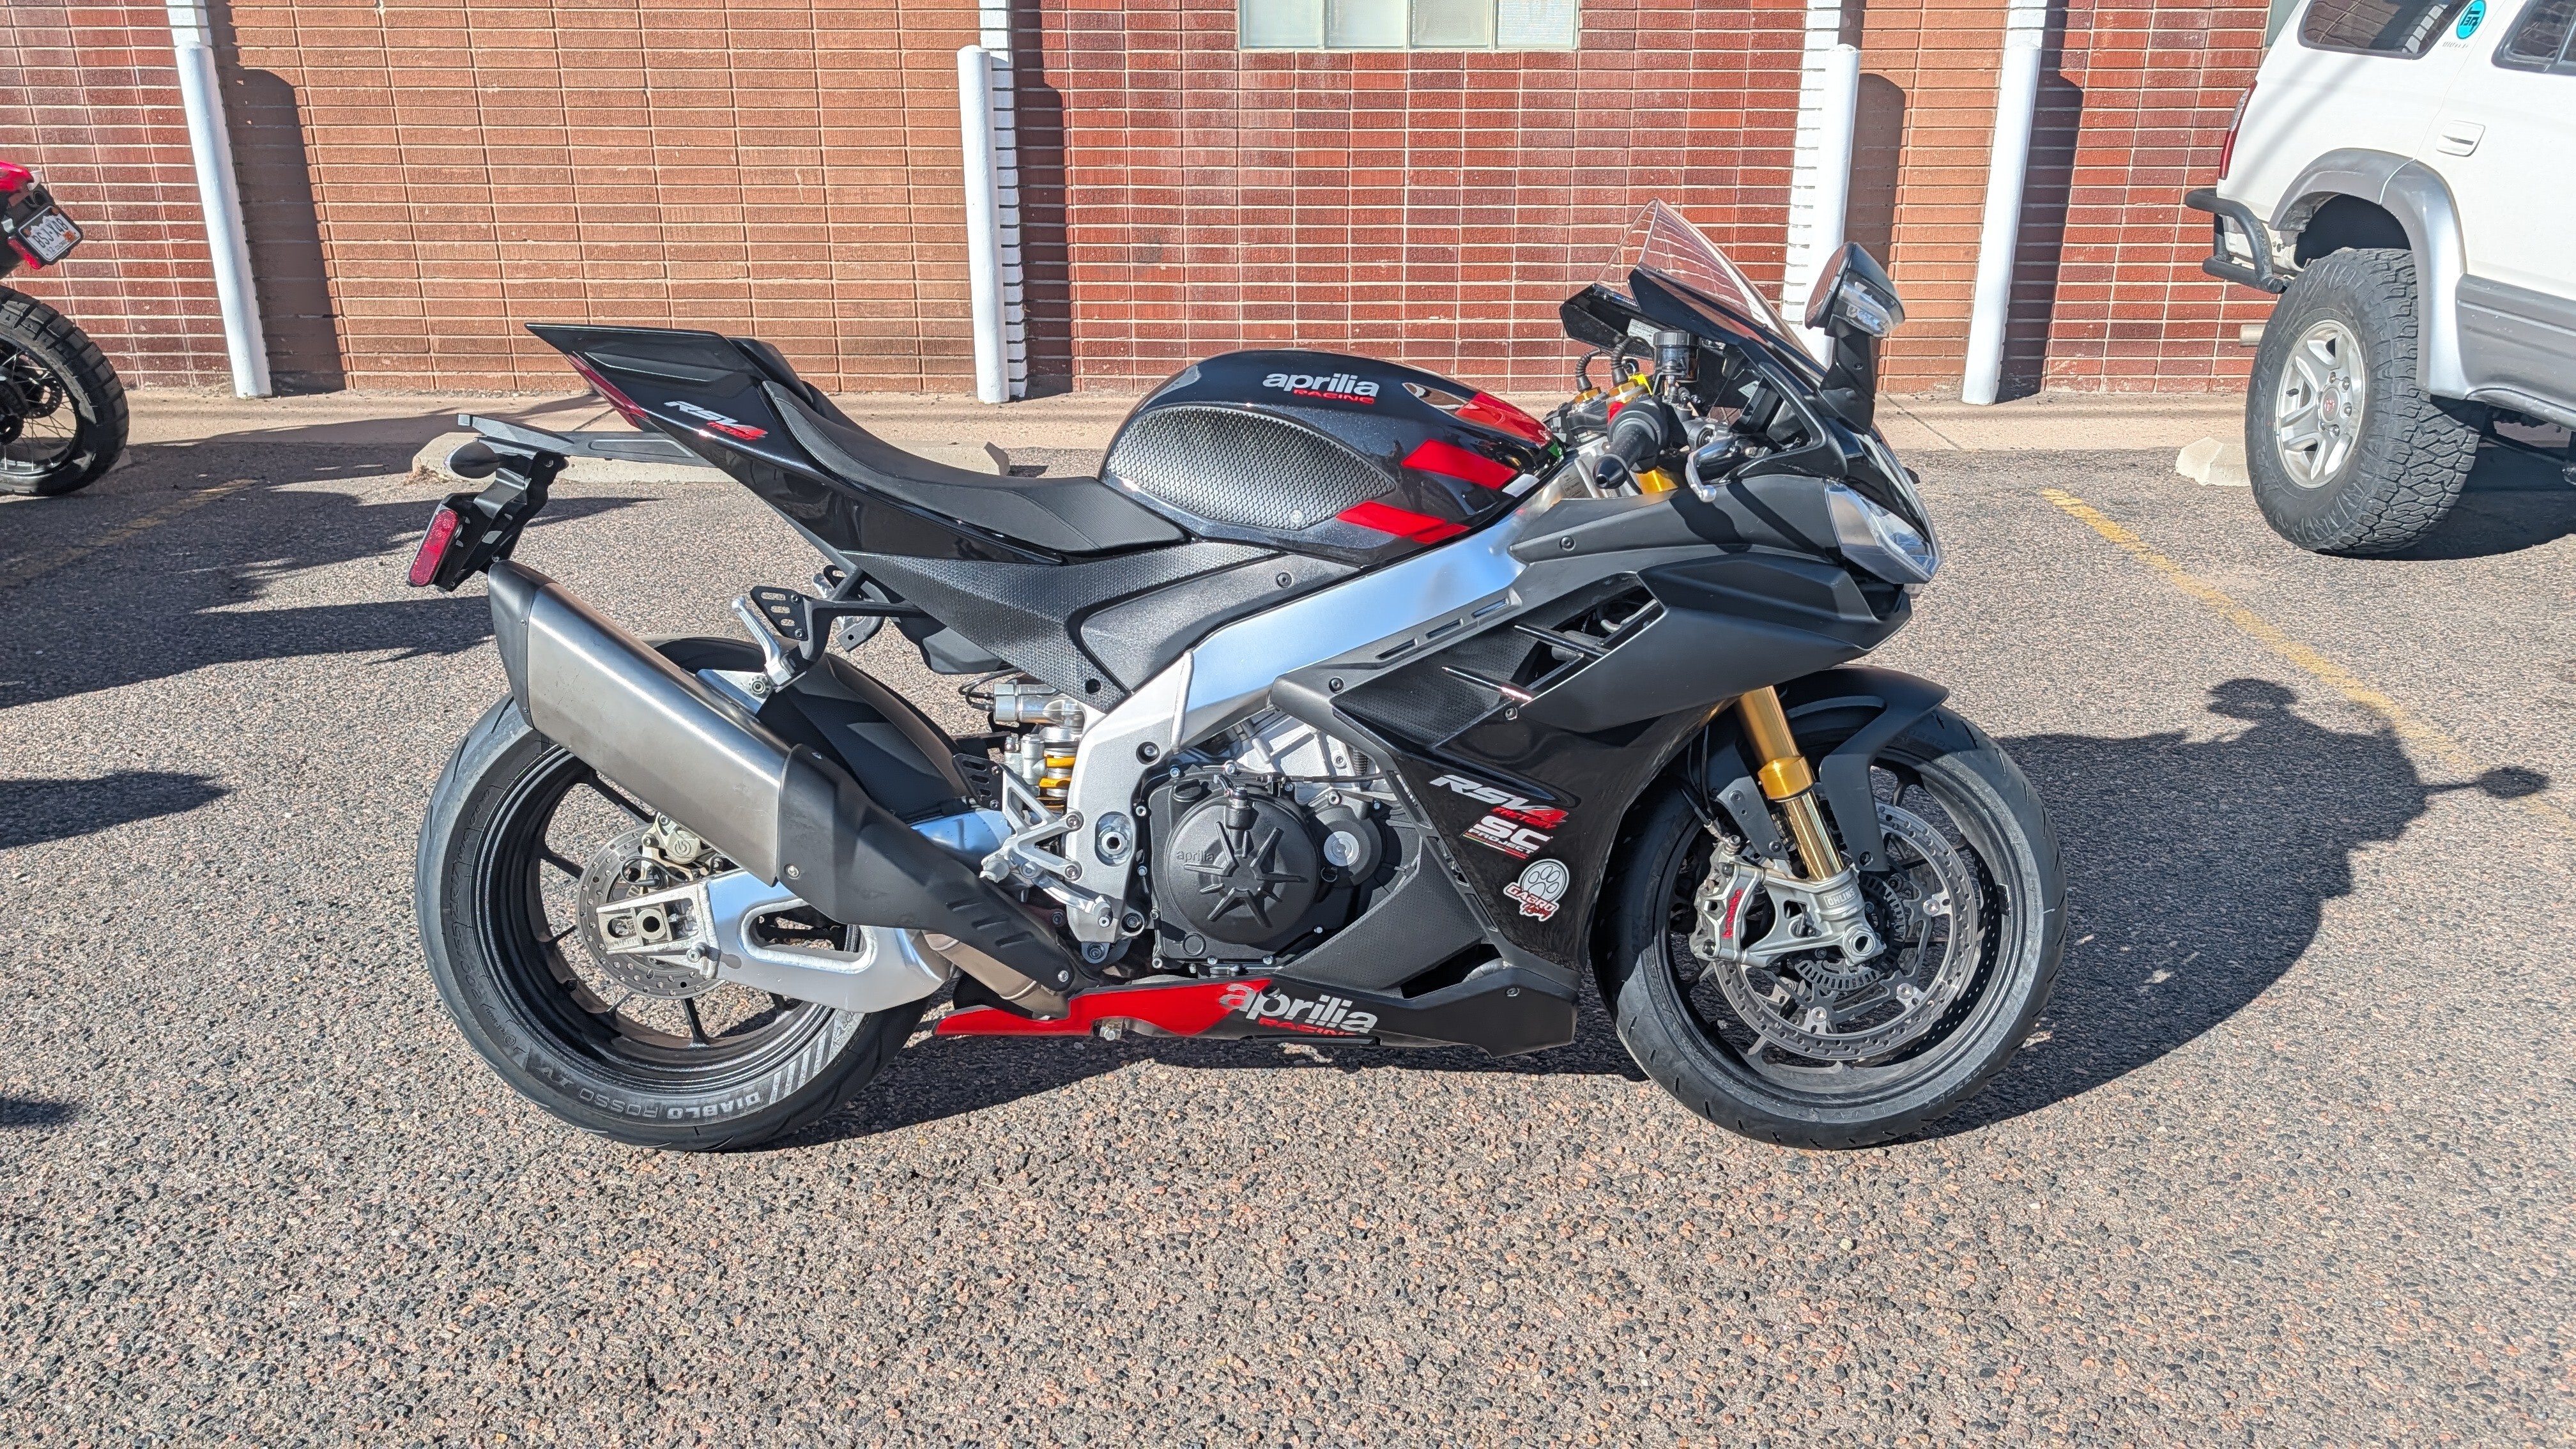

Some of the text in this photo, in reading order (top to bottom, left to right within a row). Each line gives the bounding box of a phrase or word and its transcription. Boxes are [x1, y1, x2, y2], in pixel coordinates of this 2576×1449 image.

[1262, 372, 1380, 397] aprilia
[1293, 388, 1376, 404] RACING
[1468, 827, 1535, 854] PROJECT
[1473, 815, 1553, 851] SC
[1176, 848, 1215, 862] aprilia
[1506, 884, 1558, 912] GABRO
[1827, 887, 1856, 906] ÖHLINS
[1723, 888, 1744, 939] brembo
[1219, 983, 1377, 1033] aprilia
[578, 1087, 659, 1118] ROSSO
[666, 1091, 762, 1119] DIABLO
